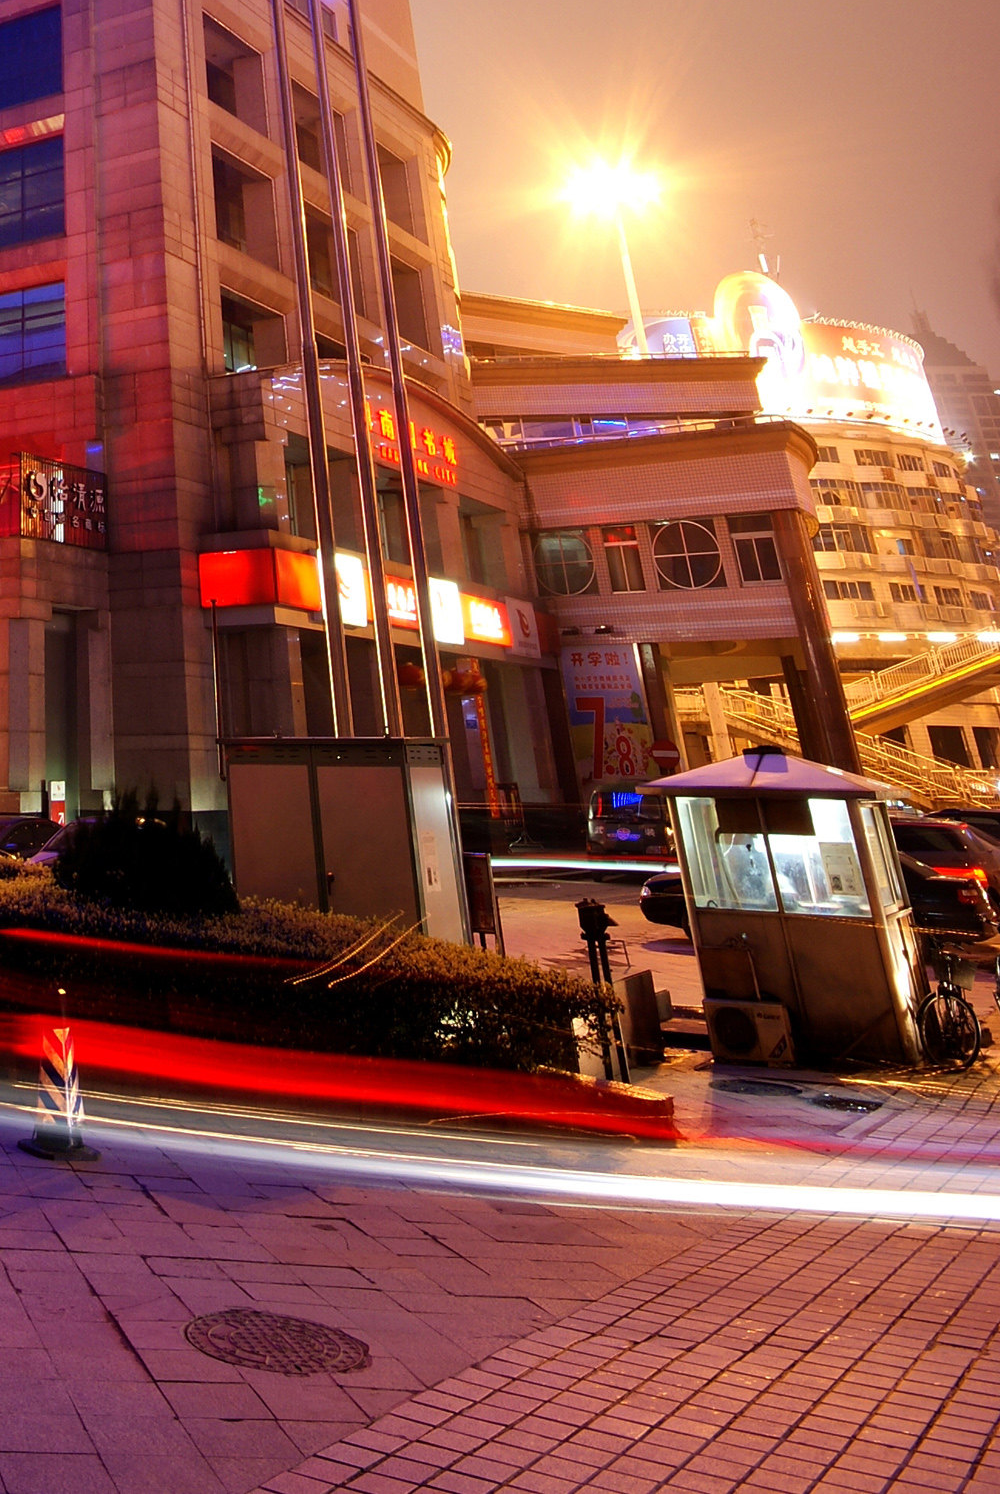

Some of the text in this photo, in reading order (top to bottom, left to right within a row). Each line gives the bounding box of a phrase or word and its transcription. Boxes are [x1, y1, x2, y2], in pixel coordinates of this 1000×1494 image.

[365, 400, 458, 466] 南书城
[48, 476, 106, 513] 怡清源
[570, 650, 630, 667] 开学啦！
